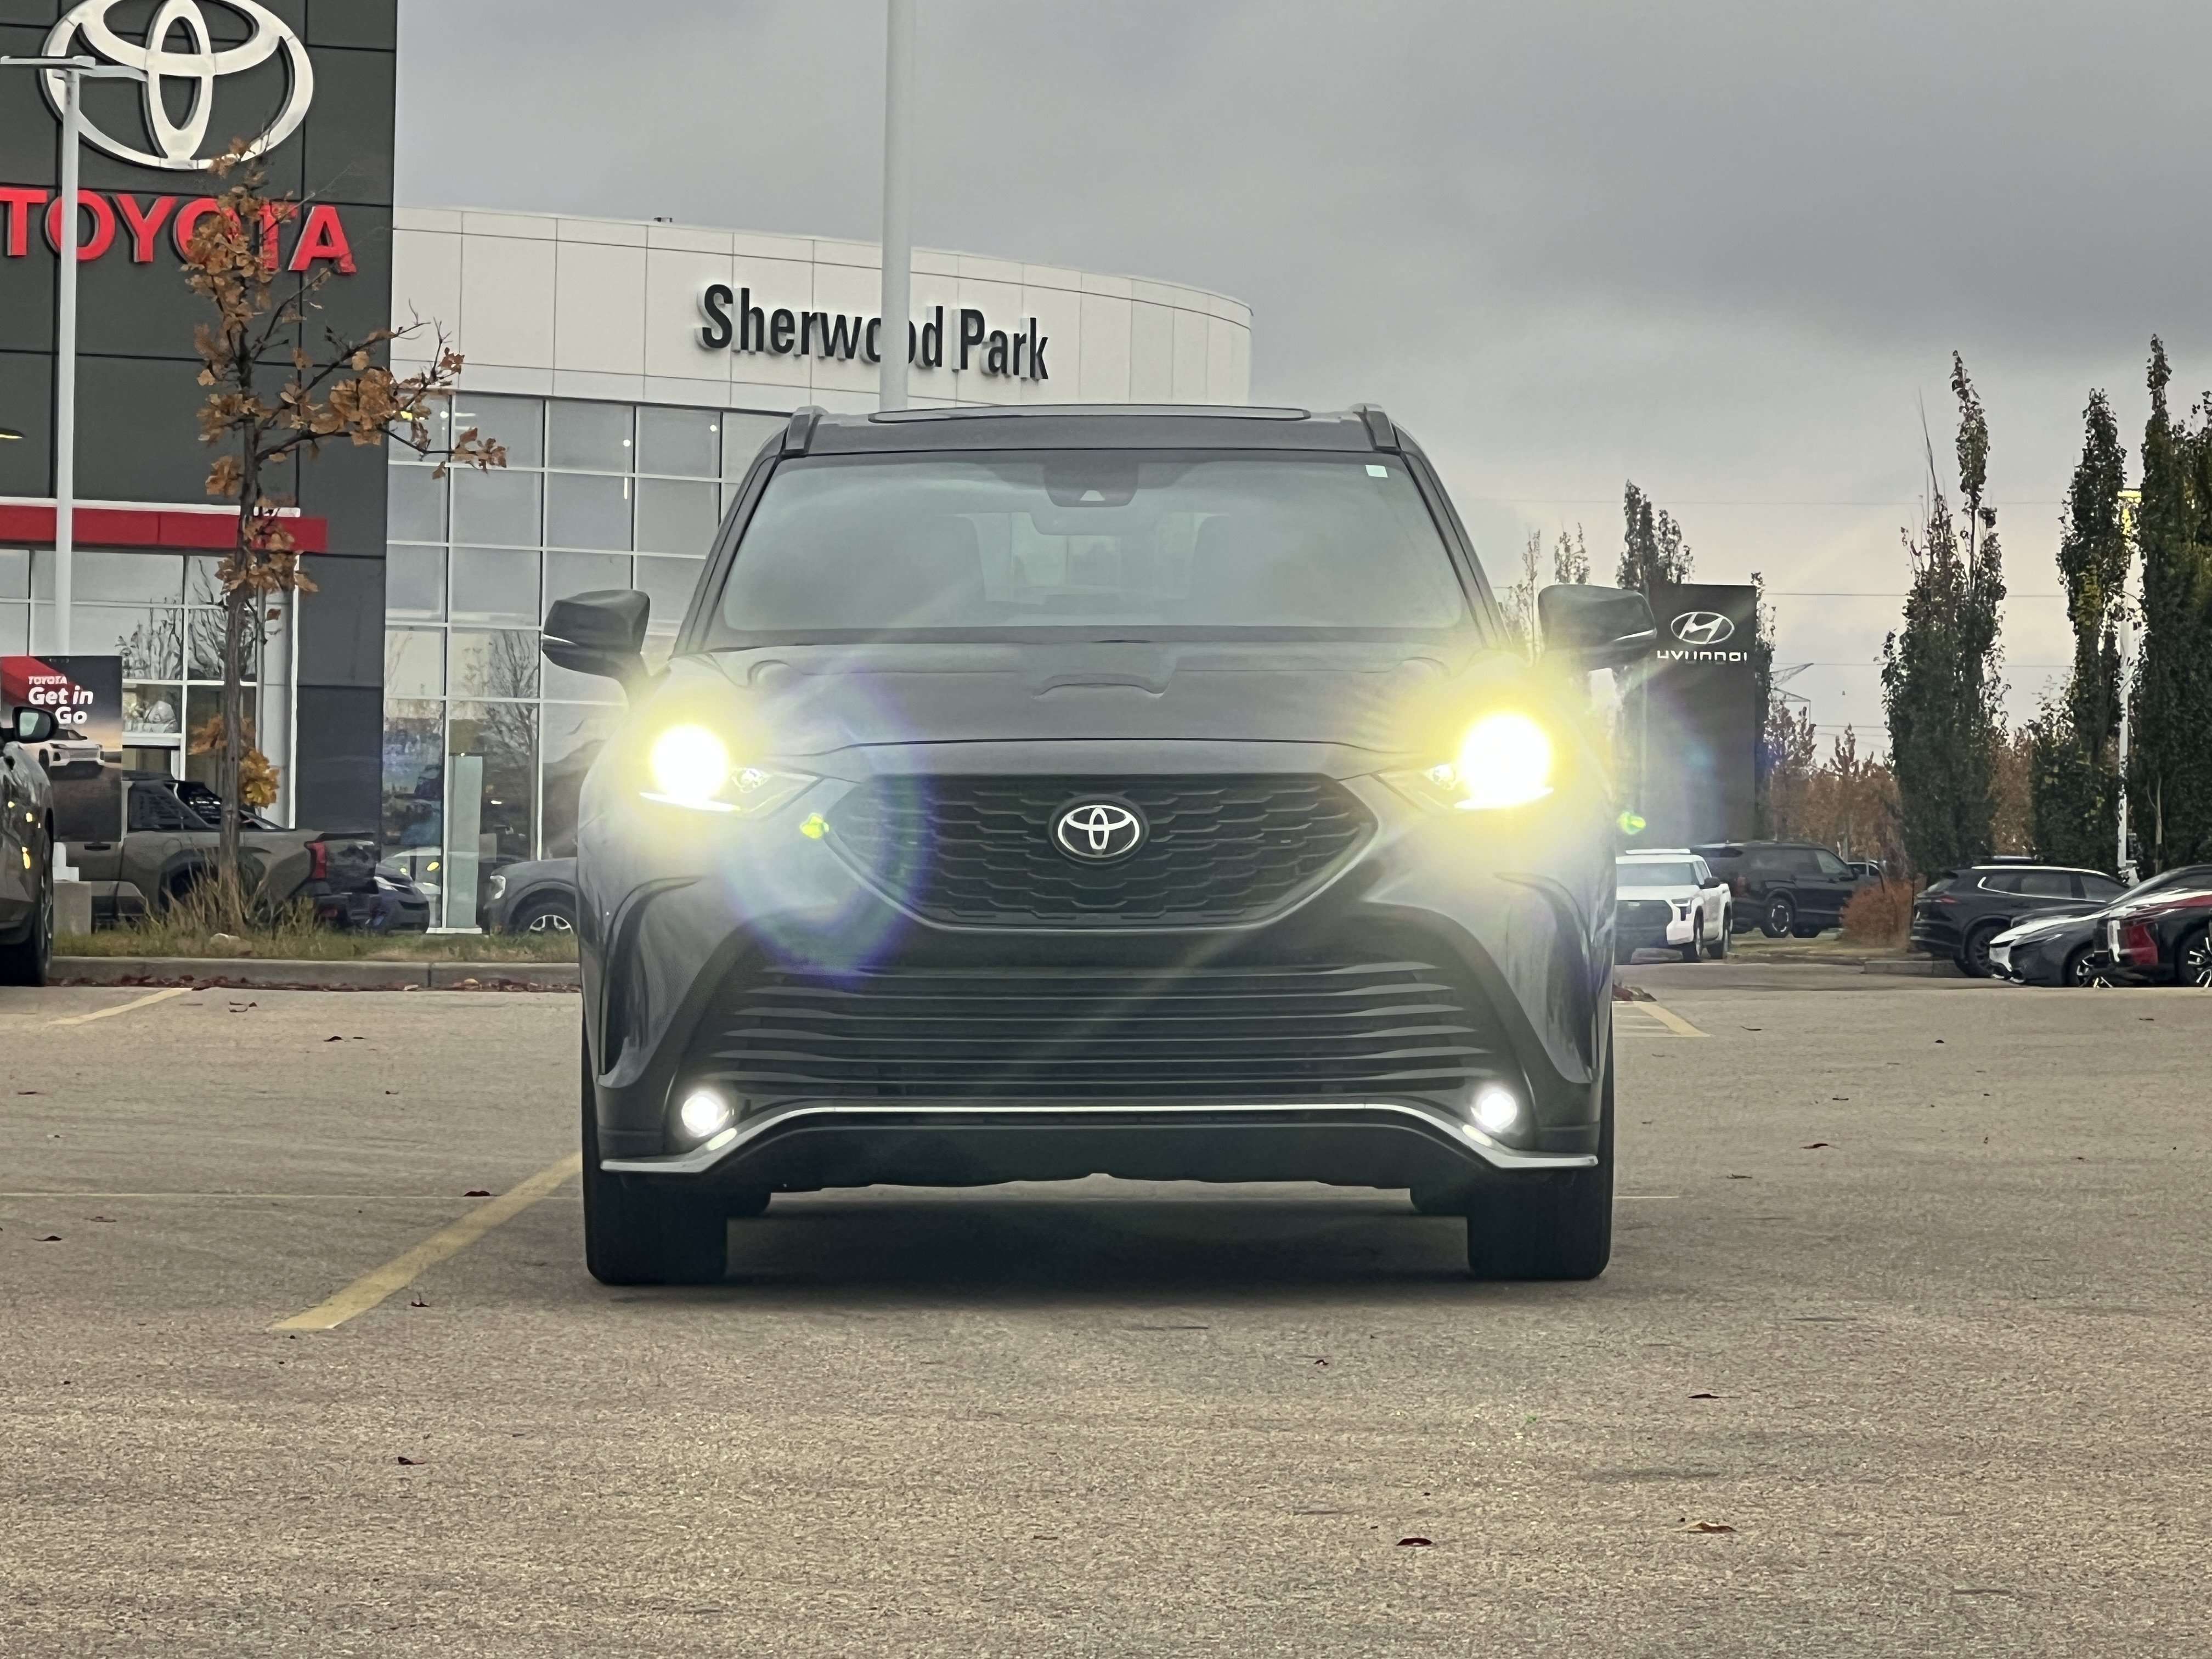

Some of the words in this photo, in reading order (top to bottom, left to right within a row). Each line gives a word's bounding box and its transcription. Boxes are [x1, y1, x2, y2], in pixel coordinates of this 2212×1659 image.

[699, 284, 944, 368] Sherwod
[956, 308, 1049, 380] Park
[28, 675, 67, 685] TOYOTA
[29, 686, 69, 705] Get
[72, 685, 94, 704] in
[55, 706, 87, 724] Go
